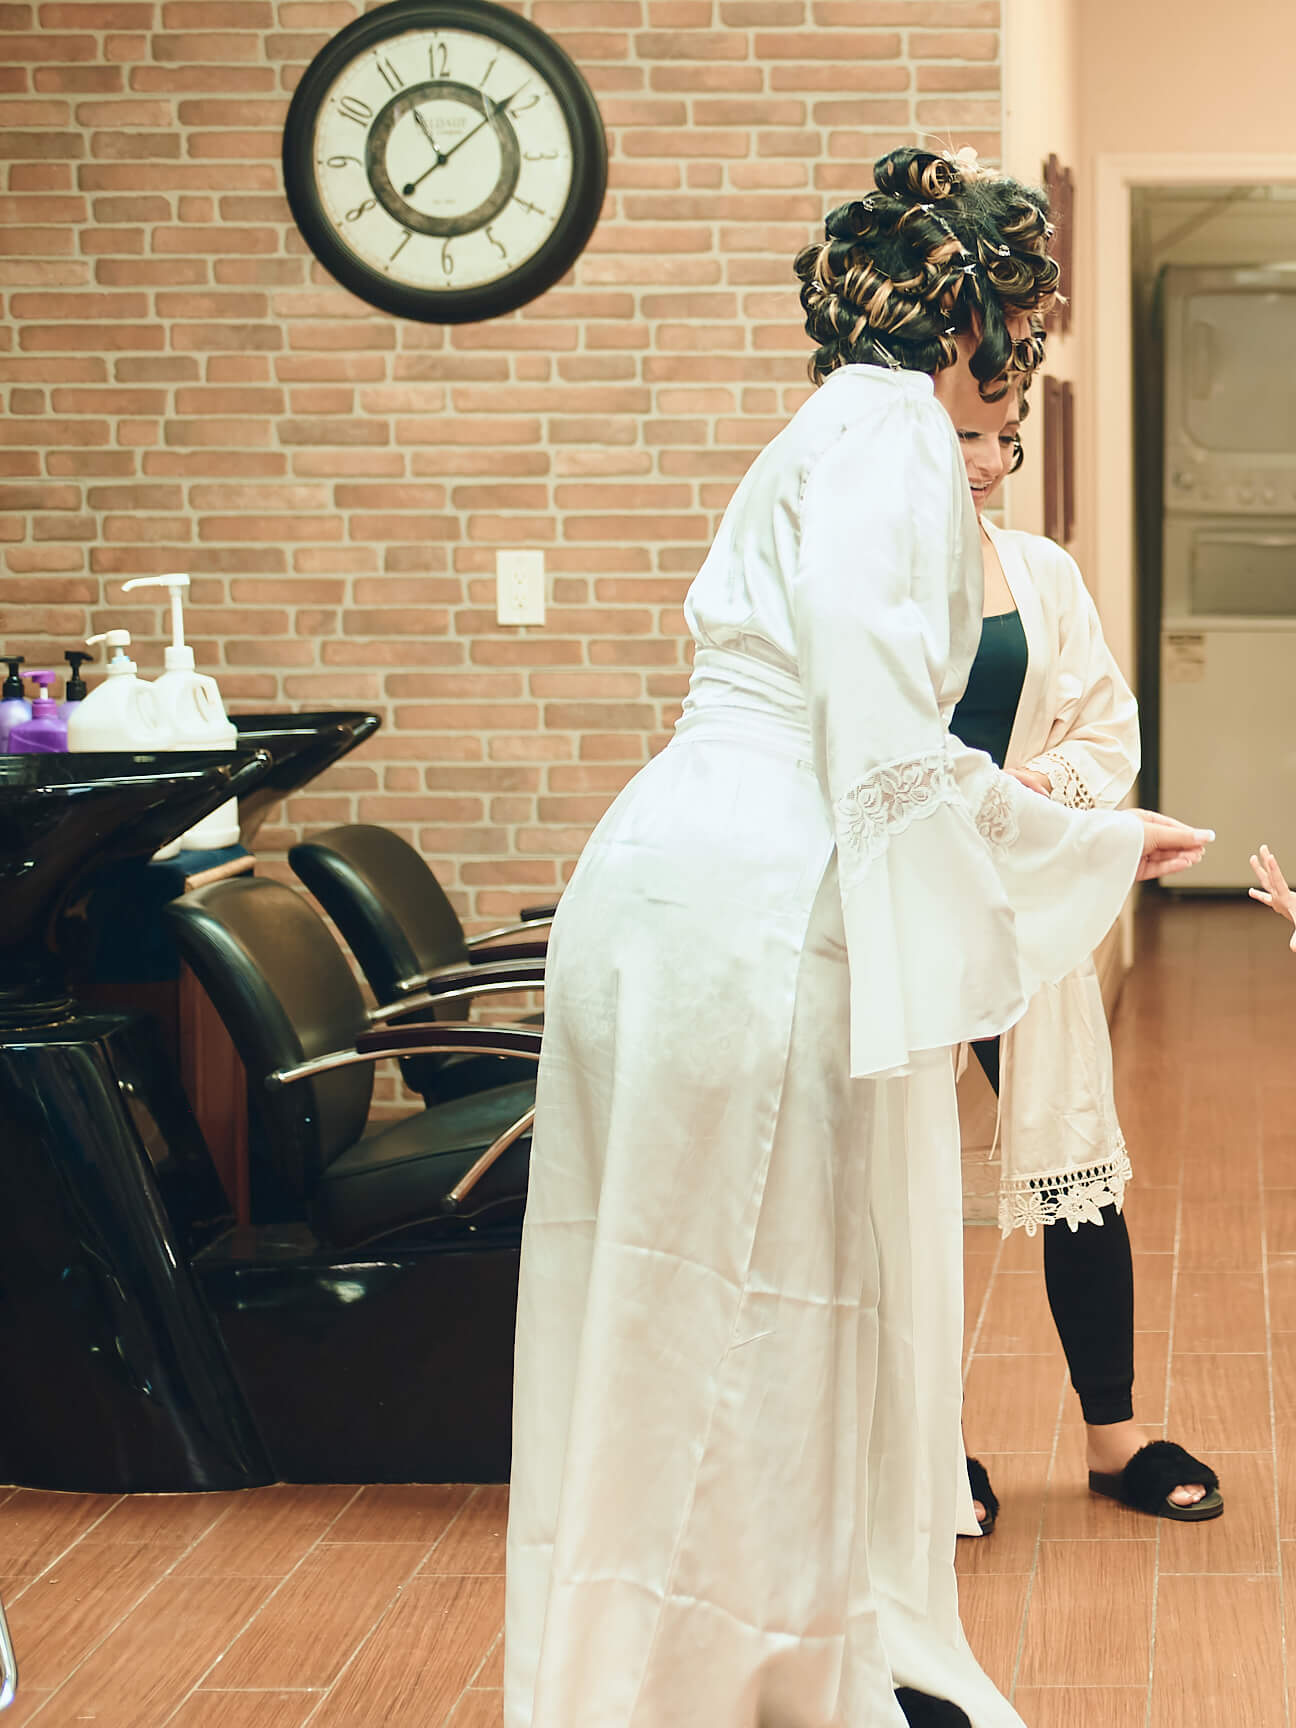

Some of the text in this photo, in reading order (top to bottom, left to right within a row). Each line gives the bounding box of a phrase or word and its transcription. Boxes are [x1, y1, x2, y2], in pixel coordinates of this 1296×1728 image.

[376, 58, 404, 92] 11
[428, 43, 450, 78] 12
[480, 58, 497, 87] 1
[337, 95, 374, 128] 10
[509, 93, 541, 119] 2
[327, 154, 362, 169] 9
[523, 151, 559, 162] 3
[345, 199, 377, 222] 8
[513, 195, 545, 216] 4
[389, 230, 412, 262] 7
[441, 238, 454, 275] 6
[485, 227, 507, 259] 5
